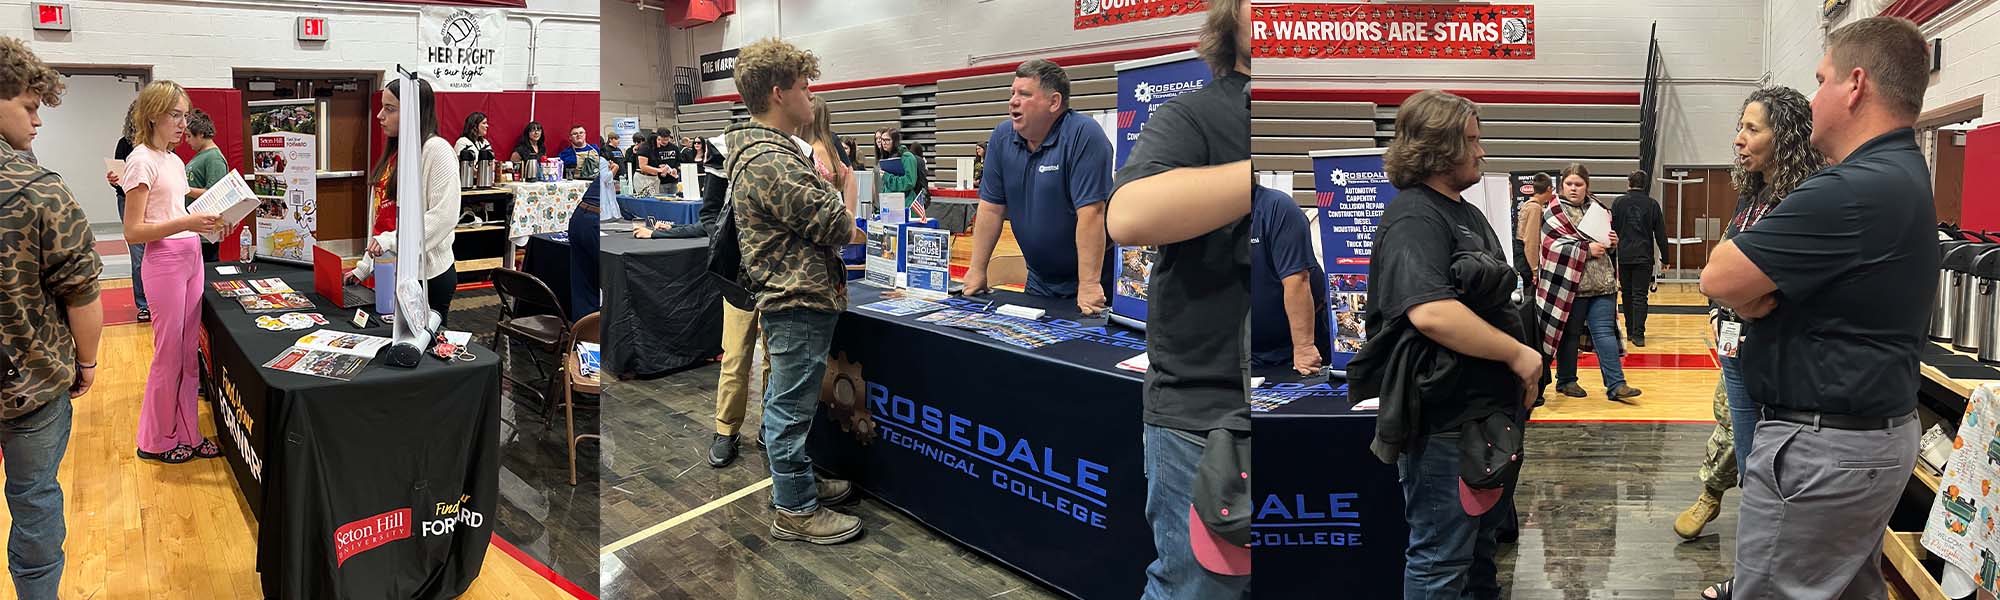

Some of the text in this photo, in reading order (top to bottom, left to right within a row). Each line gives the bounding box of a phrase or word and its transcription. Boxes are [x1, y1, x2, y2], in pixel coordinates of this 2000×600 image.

[1274, 21, 1382, 41] WARRIORS
[1389, 21, 1428, 41] ARE
[1434, 21, 1499, 42] STARS
[428, 47, 453, 64] HER
[444, 68, 460, 76] our
[461, 66, 486, 83] fight
[1149, 80, 1204, 94] ROSEDALE
[1345, 187, 1377, 195] AUTOMOTIVE
[1328, 210, 1365, 218] CONSTRUCTION
[916, 246, 939, 256] HOUSE
[918, 240, 937, 248] OPEN
[1346, 240, 1362, 248] TRUCK
[865, 380, 1109, 497] ROSEDALE
[879, 424, 980, 479] TECHNICAL
[435, 500, 461, 516] Find
[992, 469, 1108, 530] COLLEGE
[1251, 493, 1360, 519] ALE
[336, 511, 403, 550] Seton Hill
[338, 528, 405, 559] UNIVERSITY
